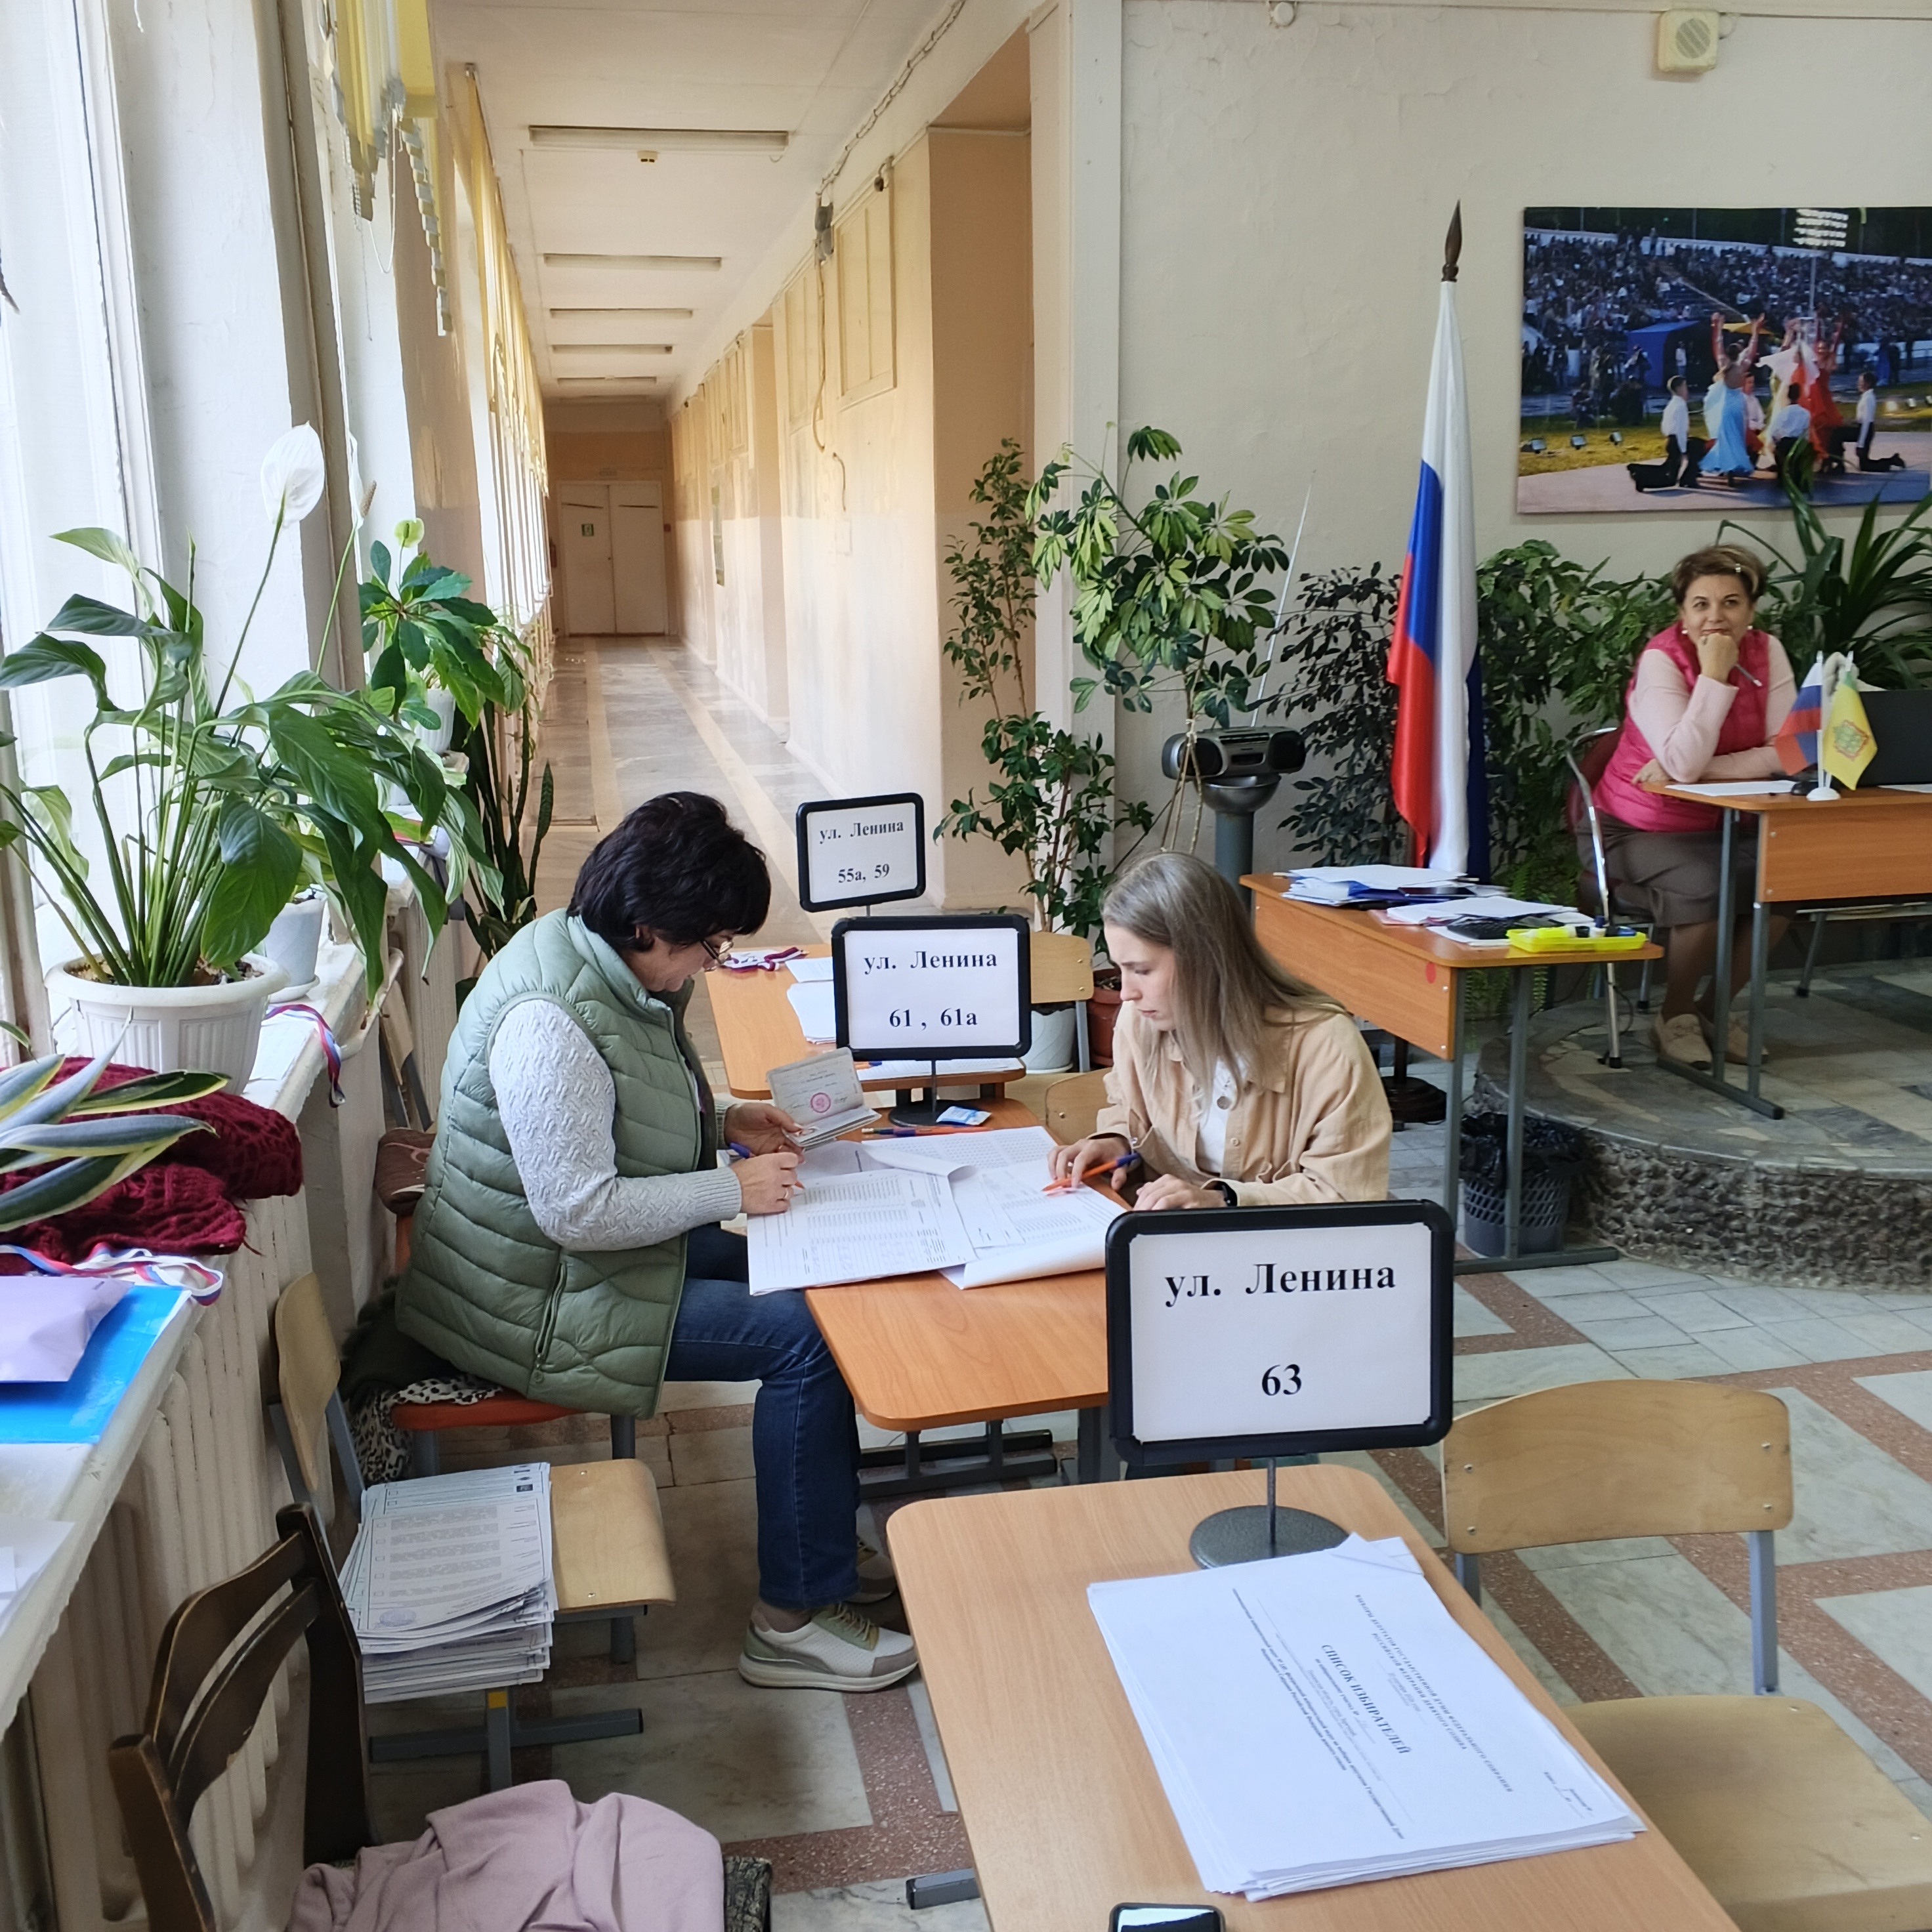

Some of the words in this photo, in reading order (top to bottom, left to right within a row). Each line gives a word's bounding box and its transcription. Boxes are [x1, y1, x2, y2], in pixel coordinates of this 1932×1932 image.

[820, 828, 841, 845] ул.
[850, 821, 904, 837] Ленина
[838, 867, 866, 883] 55а,
[874, 863, 890, 879] 59
[864, 956, 896, 975] ул.
[910, 950, 997, 969] Ленина
[940, 1007, 977, 1026] 61а
[1165, 1274, 1221, 1308] ул.
[1245, 1263, 1396, 1294] Ленина
[1261, 1363, 1302, 1396] 63
[1319, 1643, 1358, 1683] СПИСОК
[1348, 1683, 1414, 1754] ИЗБИРАТЕЛЕЙ
